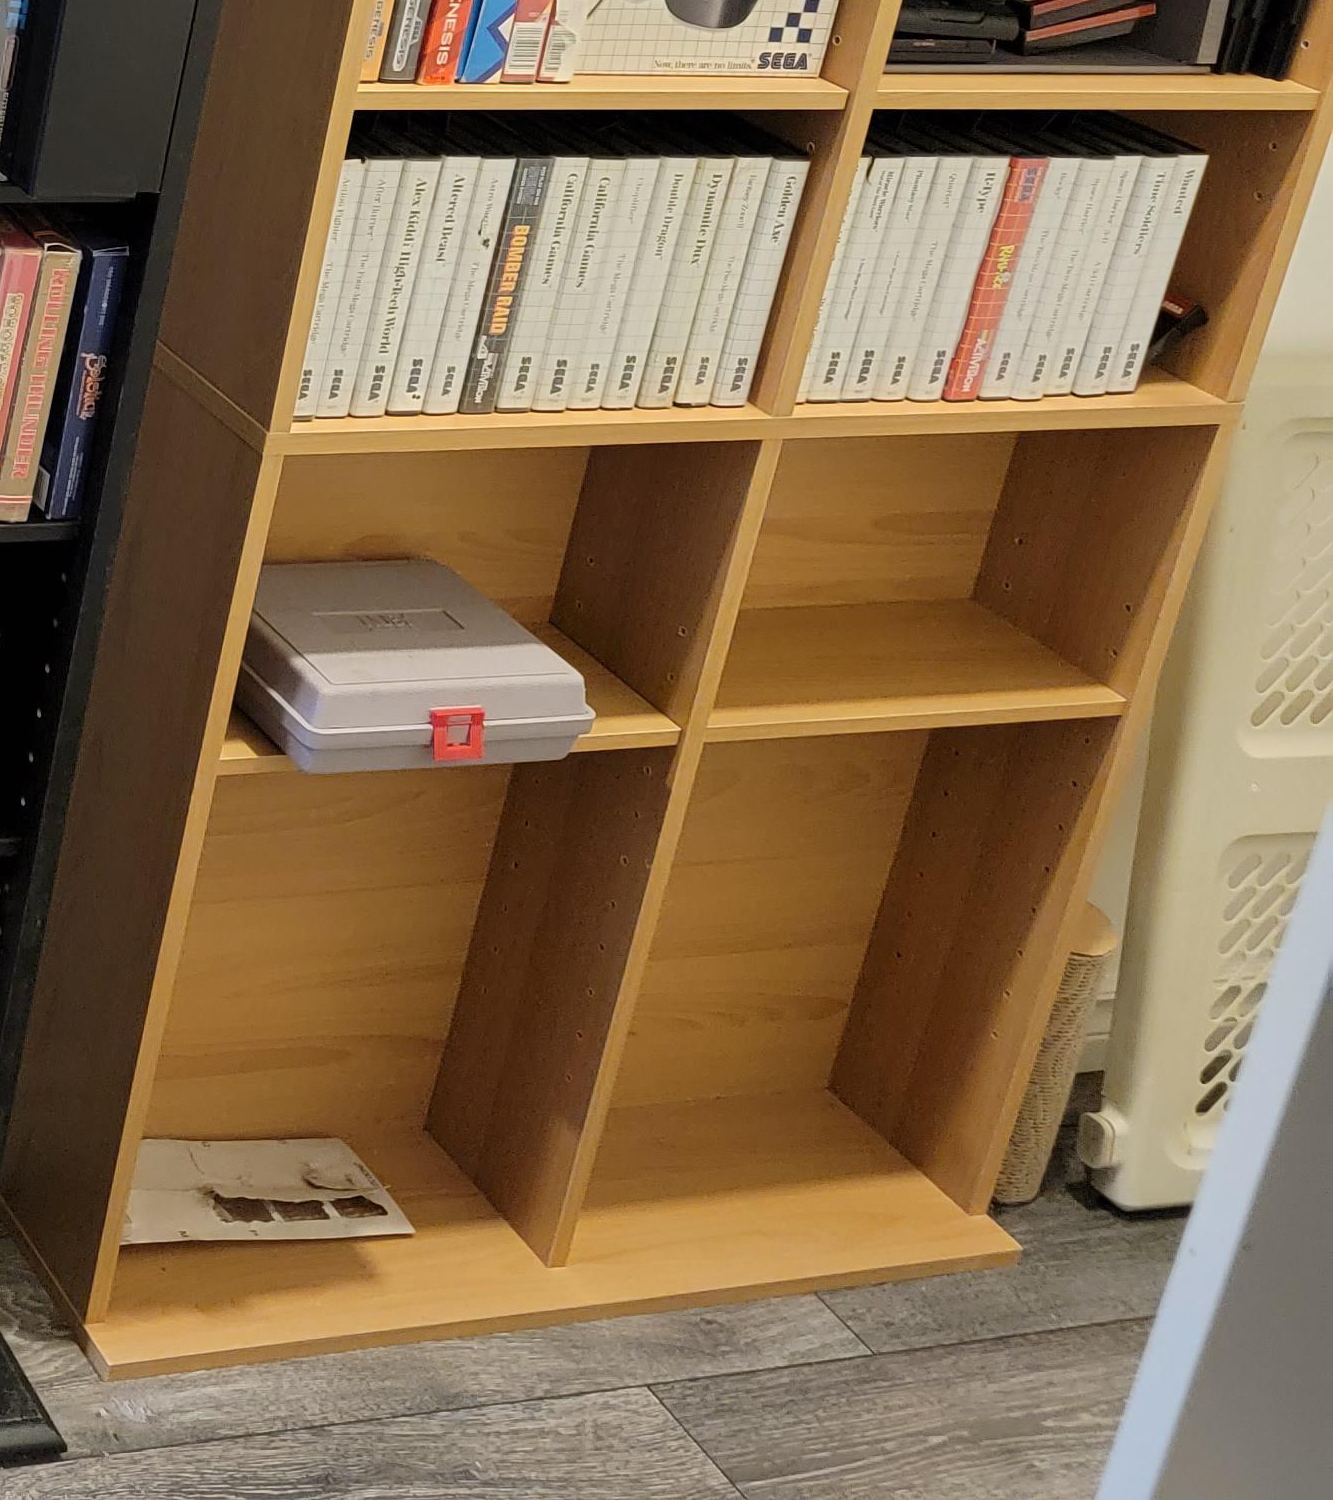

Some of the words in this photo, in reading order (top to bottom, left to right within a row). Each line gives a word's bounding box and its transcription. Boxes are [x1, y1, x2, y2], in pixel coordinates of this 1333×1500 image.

[757, 52, 810, 71] SEGA
[497, 224, 531, 292] BOMBER
[489, 294, 514, 335] RAID
